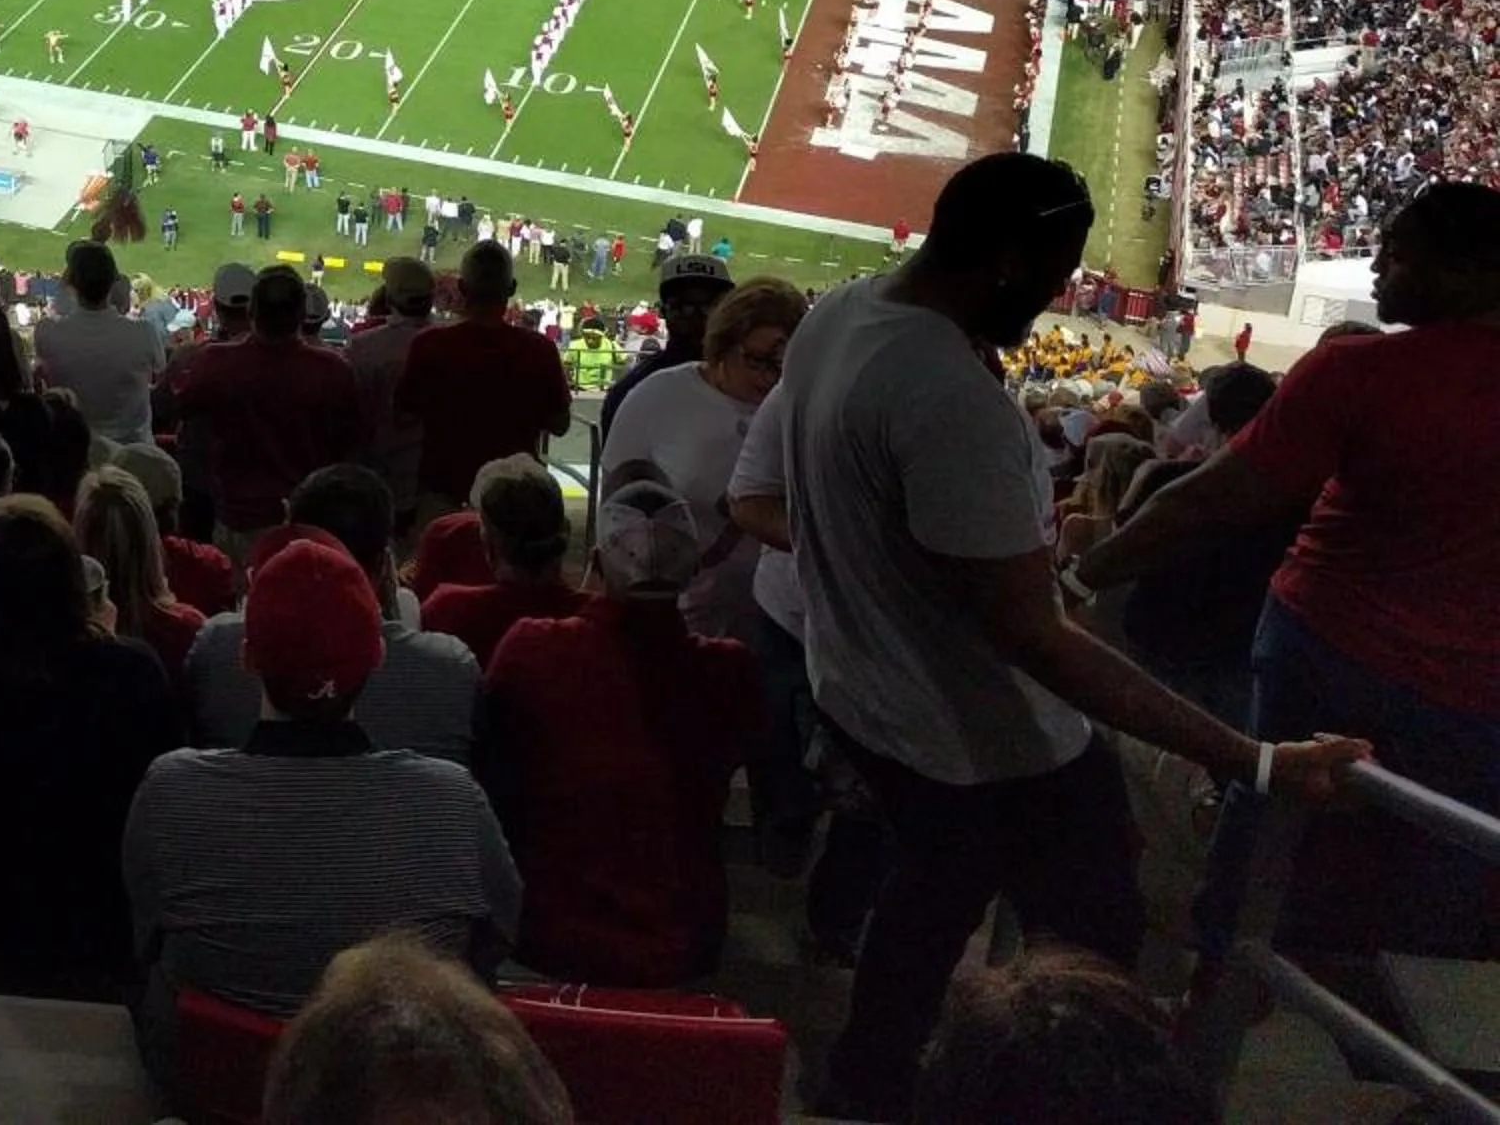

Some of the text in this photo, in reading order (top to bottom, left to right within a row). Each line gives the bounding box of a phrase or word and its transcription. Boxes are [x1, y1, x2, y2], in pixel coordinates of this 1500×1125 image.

[93, 5, 167, 31] 30
[283, 34, 363, 61] 20
[501, 66, 578, 95] 10
